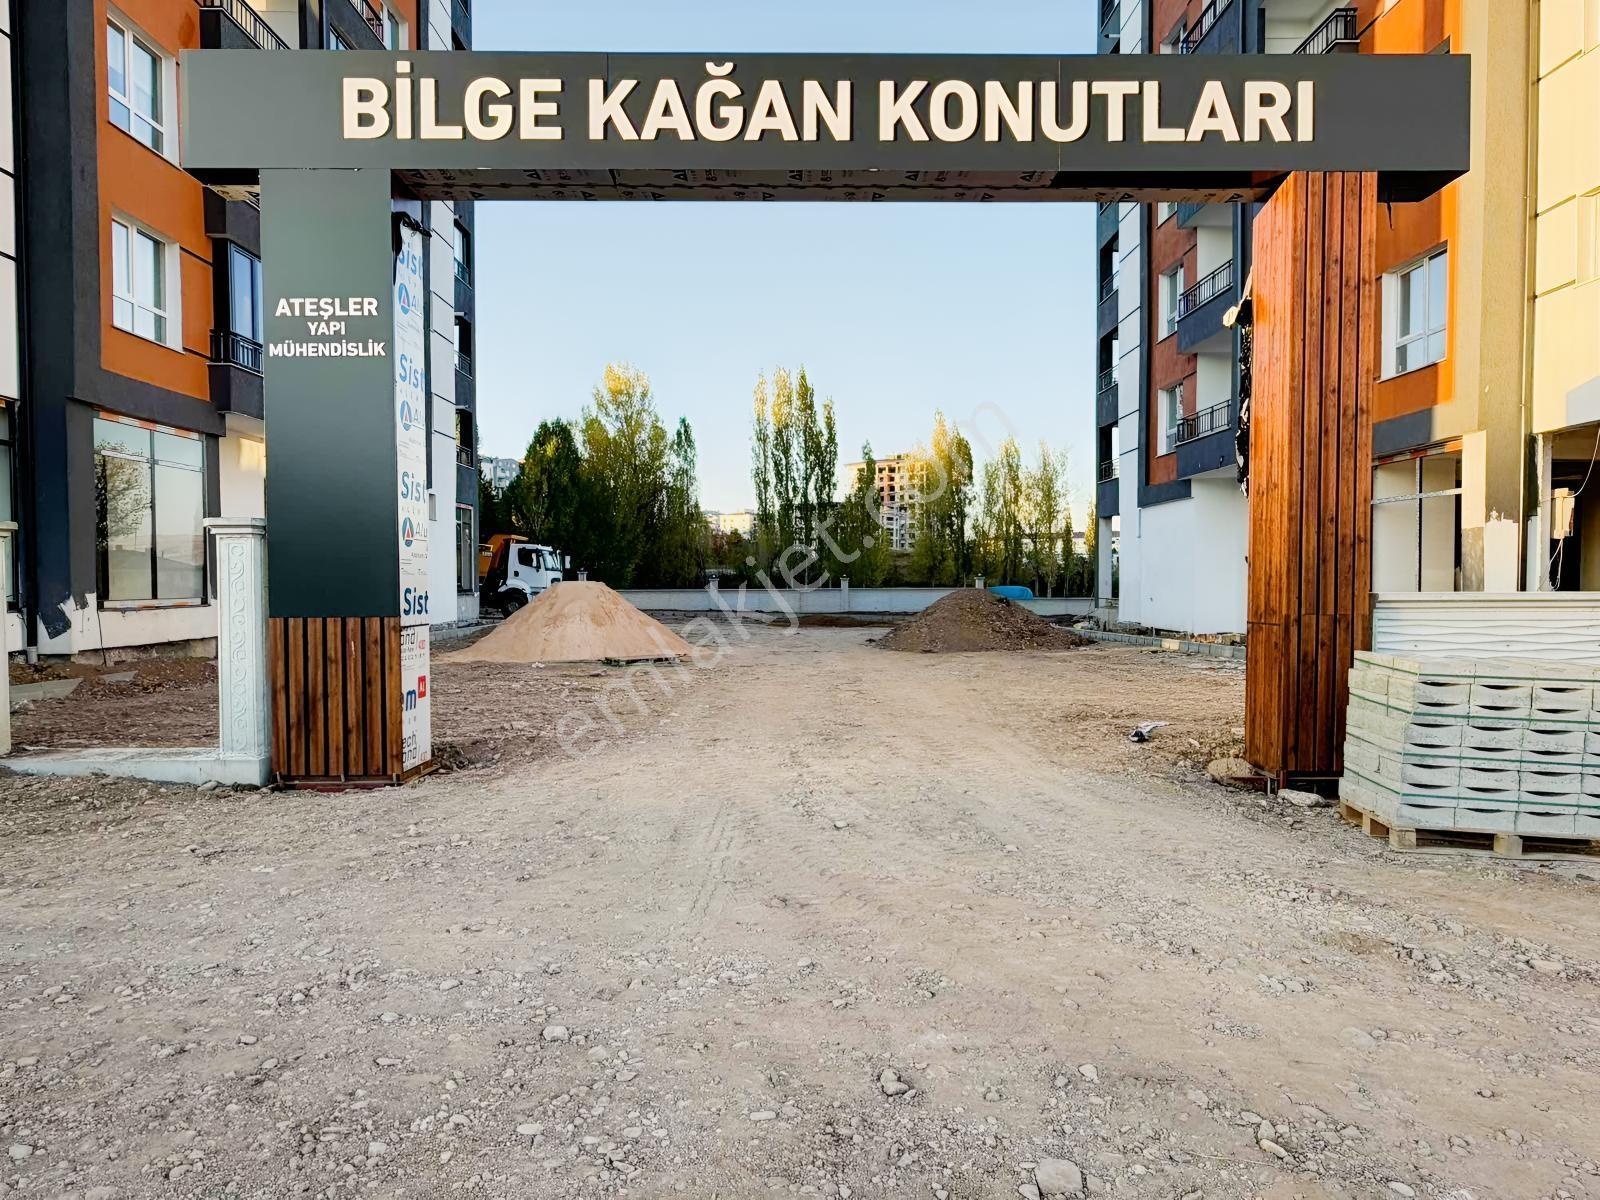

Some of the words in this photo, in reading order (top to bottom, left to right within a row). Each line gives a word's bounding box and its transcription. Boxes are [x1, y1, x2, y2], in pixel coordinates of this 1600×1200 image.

[342, 60, 562, 141] BİLGE
[588, 62, 851, 142] KAĞAN
[879, 80, 1314, 143] KONUTLARI
[275, 298, 378, 320] ATEŞLER
[307, 321, 346, 336] YAPI
[269, 339, 386, 357] MÜHENDİSLİK
[403, 587, 428, 616] Sist
